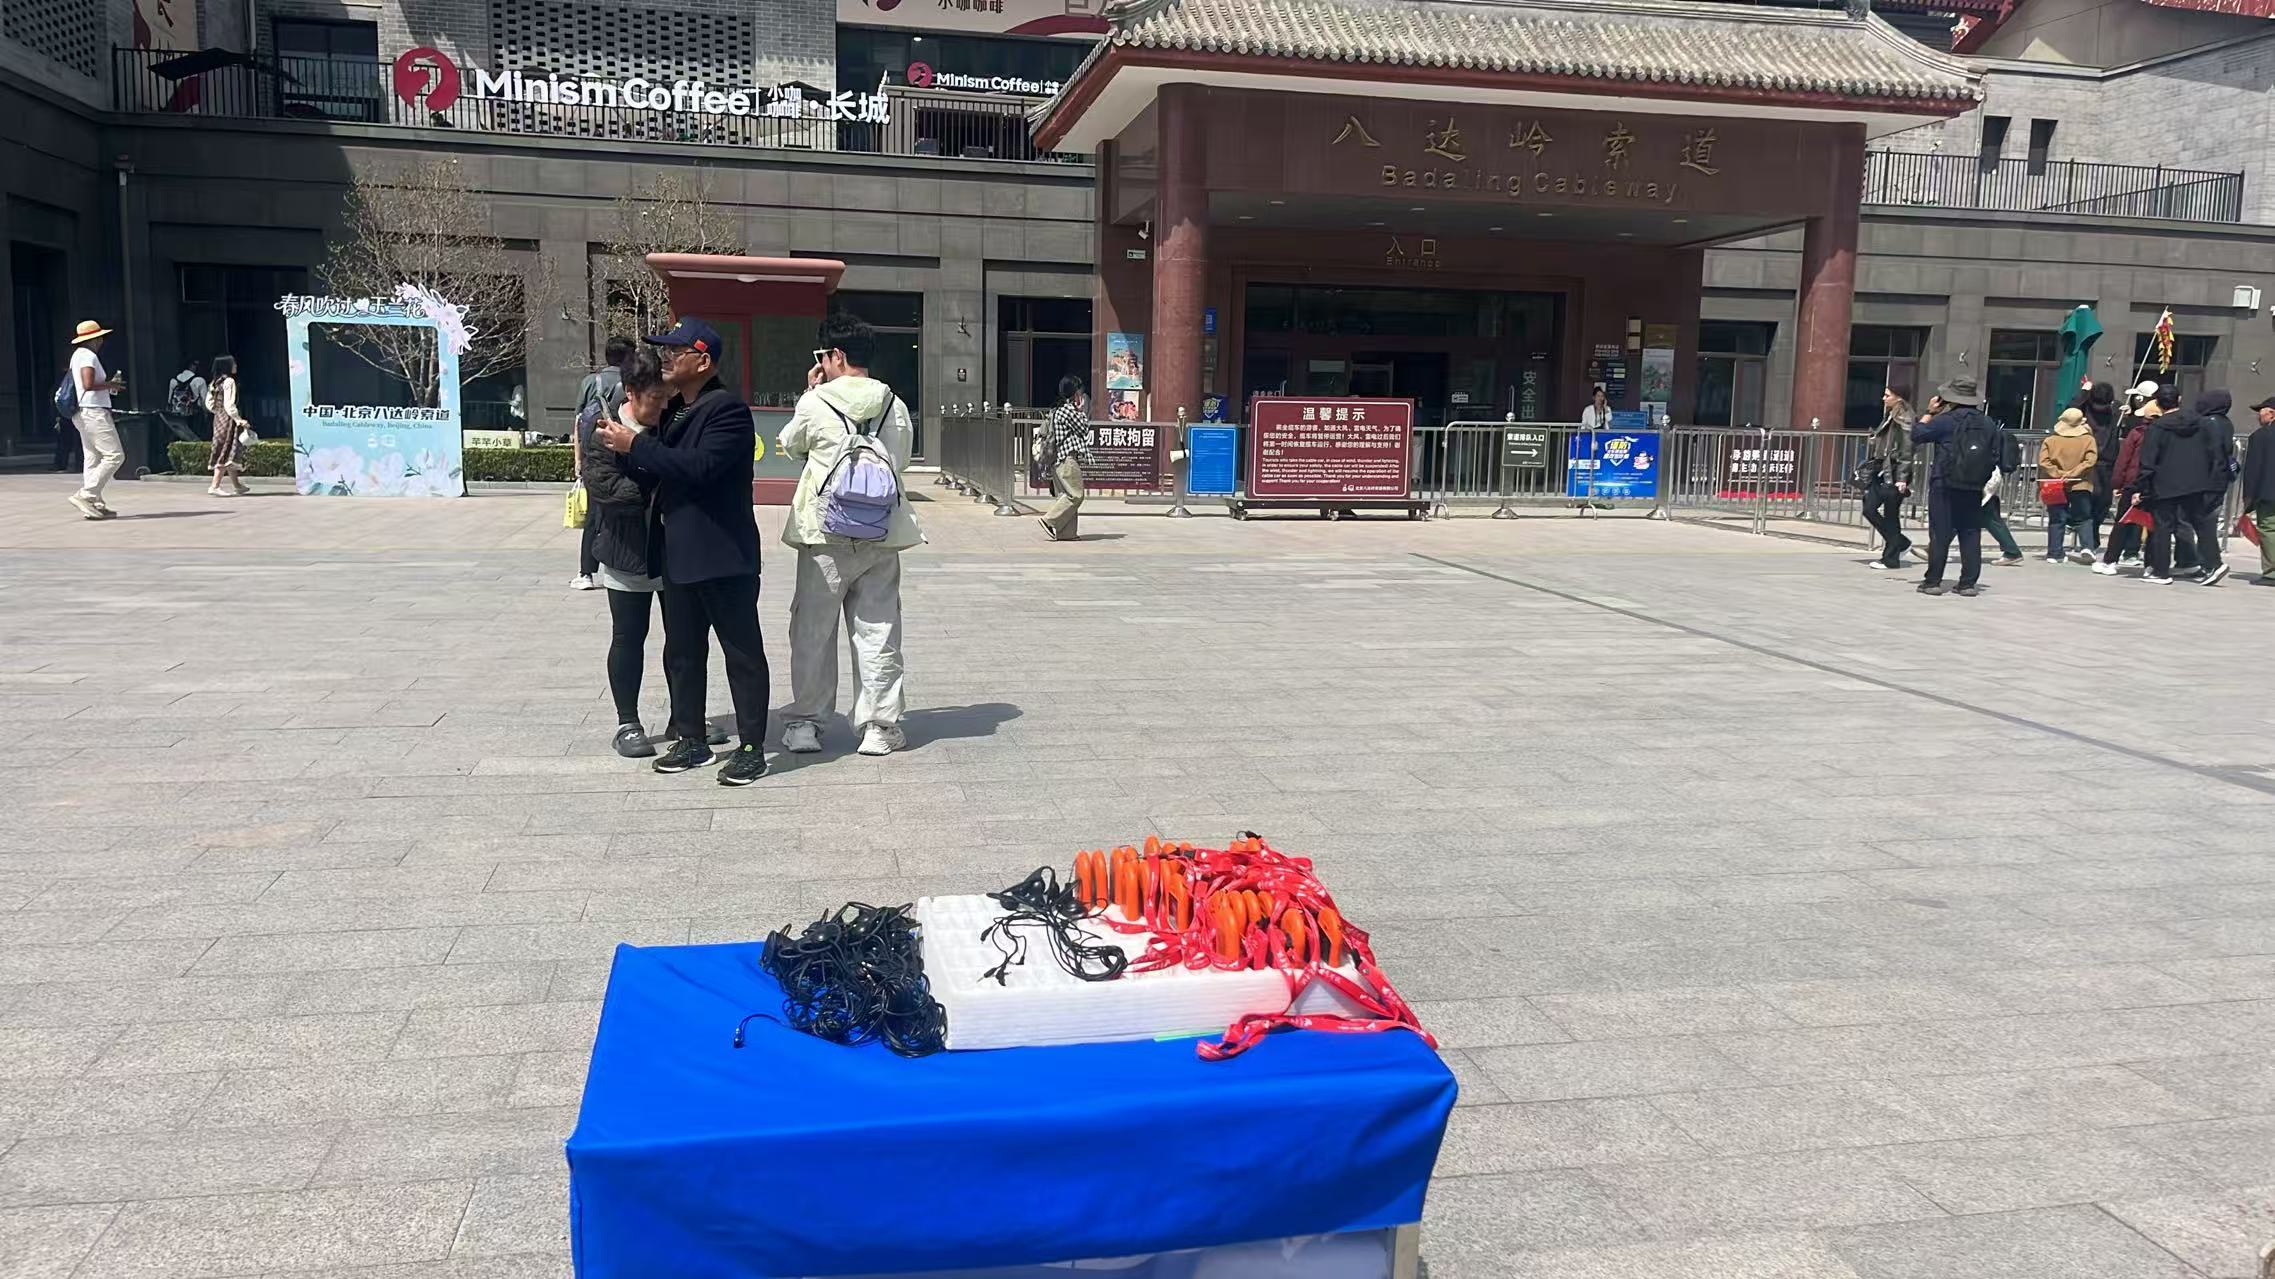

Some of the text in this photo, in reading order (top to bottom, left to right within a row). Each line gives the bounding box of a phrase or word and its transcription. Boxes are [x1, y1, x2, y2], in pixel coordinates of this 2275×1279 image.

[475, 68, 751, 116] Minism Coffee
[936, 72, 1040, 93] Minism Coffee
[1331, 115, 1721, 176] 八达岭索道
[1380, 164, 1680, 203] Badaling Cableway
[1386, 236, 1437, 256] 入口
[1302, 407, 1366, 421] 温馨提示
[1099, 427, 1155, 447] 罚款拘留
